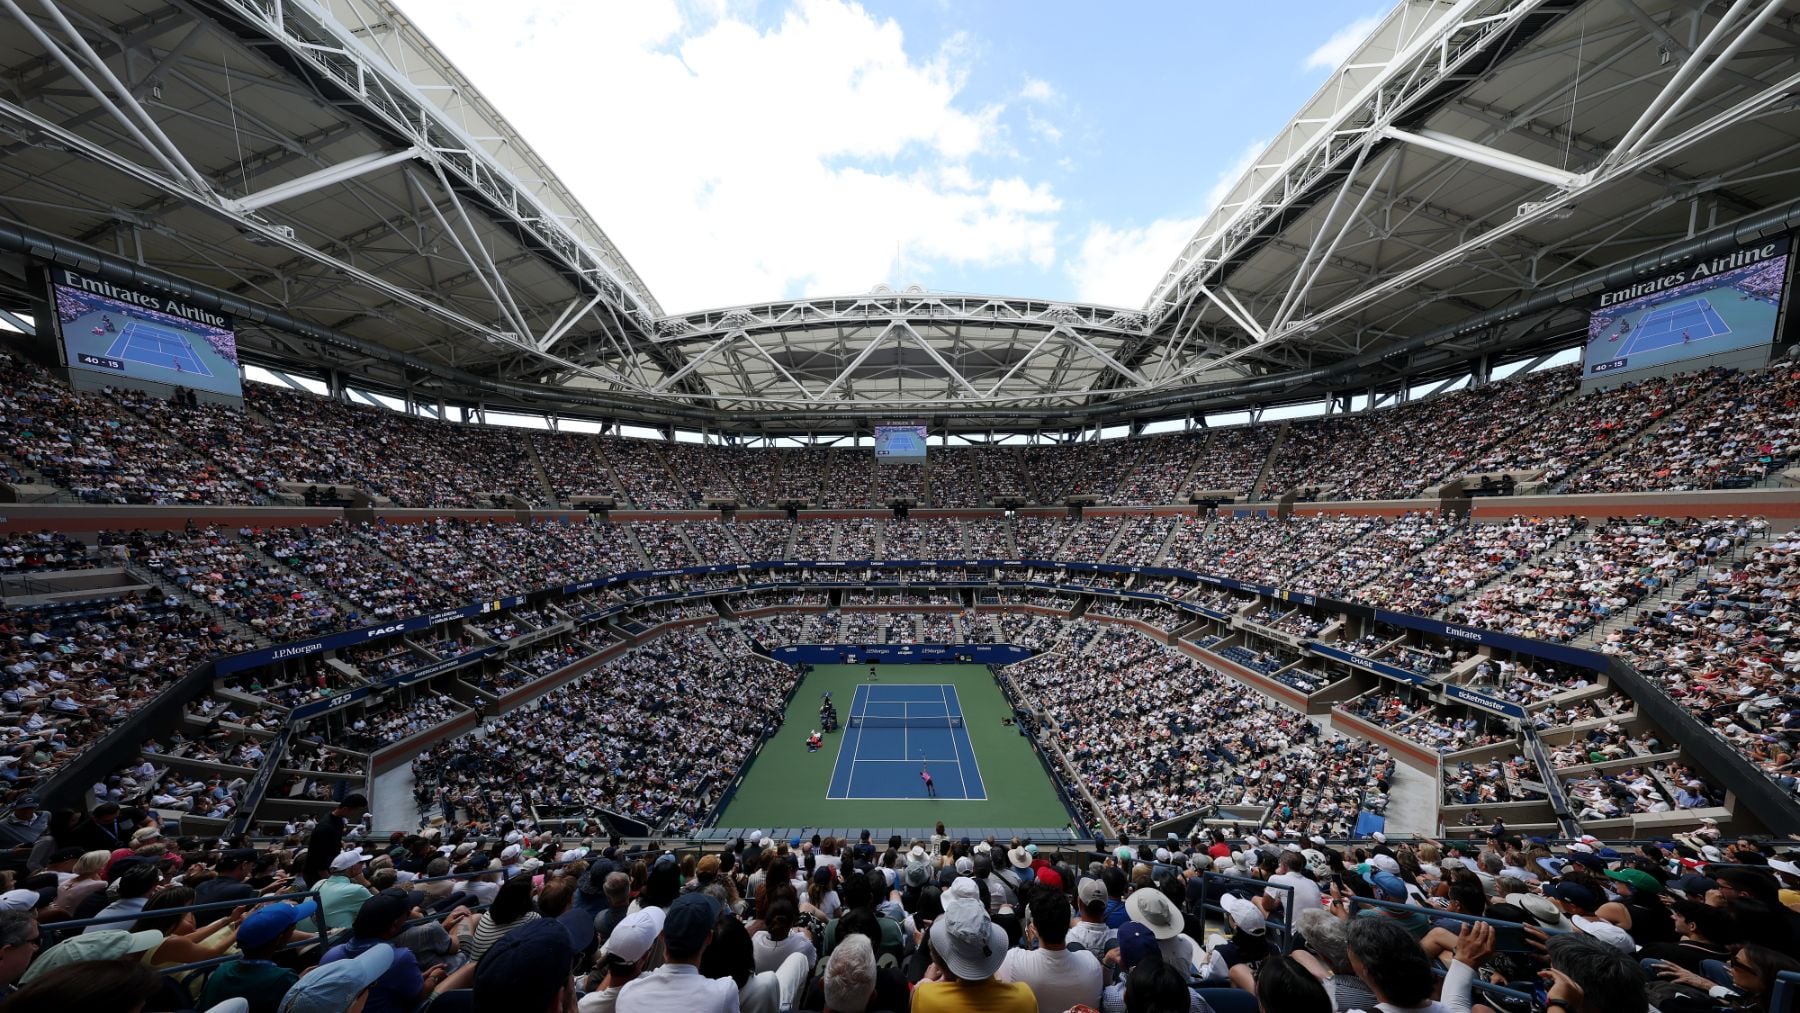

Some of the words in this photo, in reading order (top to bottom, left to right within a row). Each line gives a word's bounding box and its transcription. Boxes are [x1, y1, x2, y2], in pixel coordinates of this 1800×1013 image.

[1600, 271, 1685, 307] Emirates
[1691, 243, 1776, 279] Airline
[64, 269, 161, 309] Emirates
[166, 300, 225, 327] Airline
[1445, 626, 1482, 641] Emirates
[271, 642, 322, 660] J.P.Morgan
[1350, 656, 1374, 669] CHASE
[328, 693, 352, 708] ATP
[1458, 691, 1505, 711] ticketmaster
